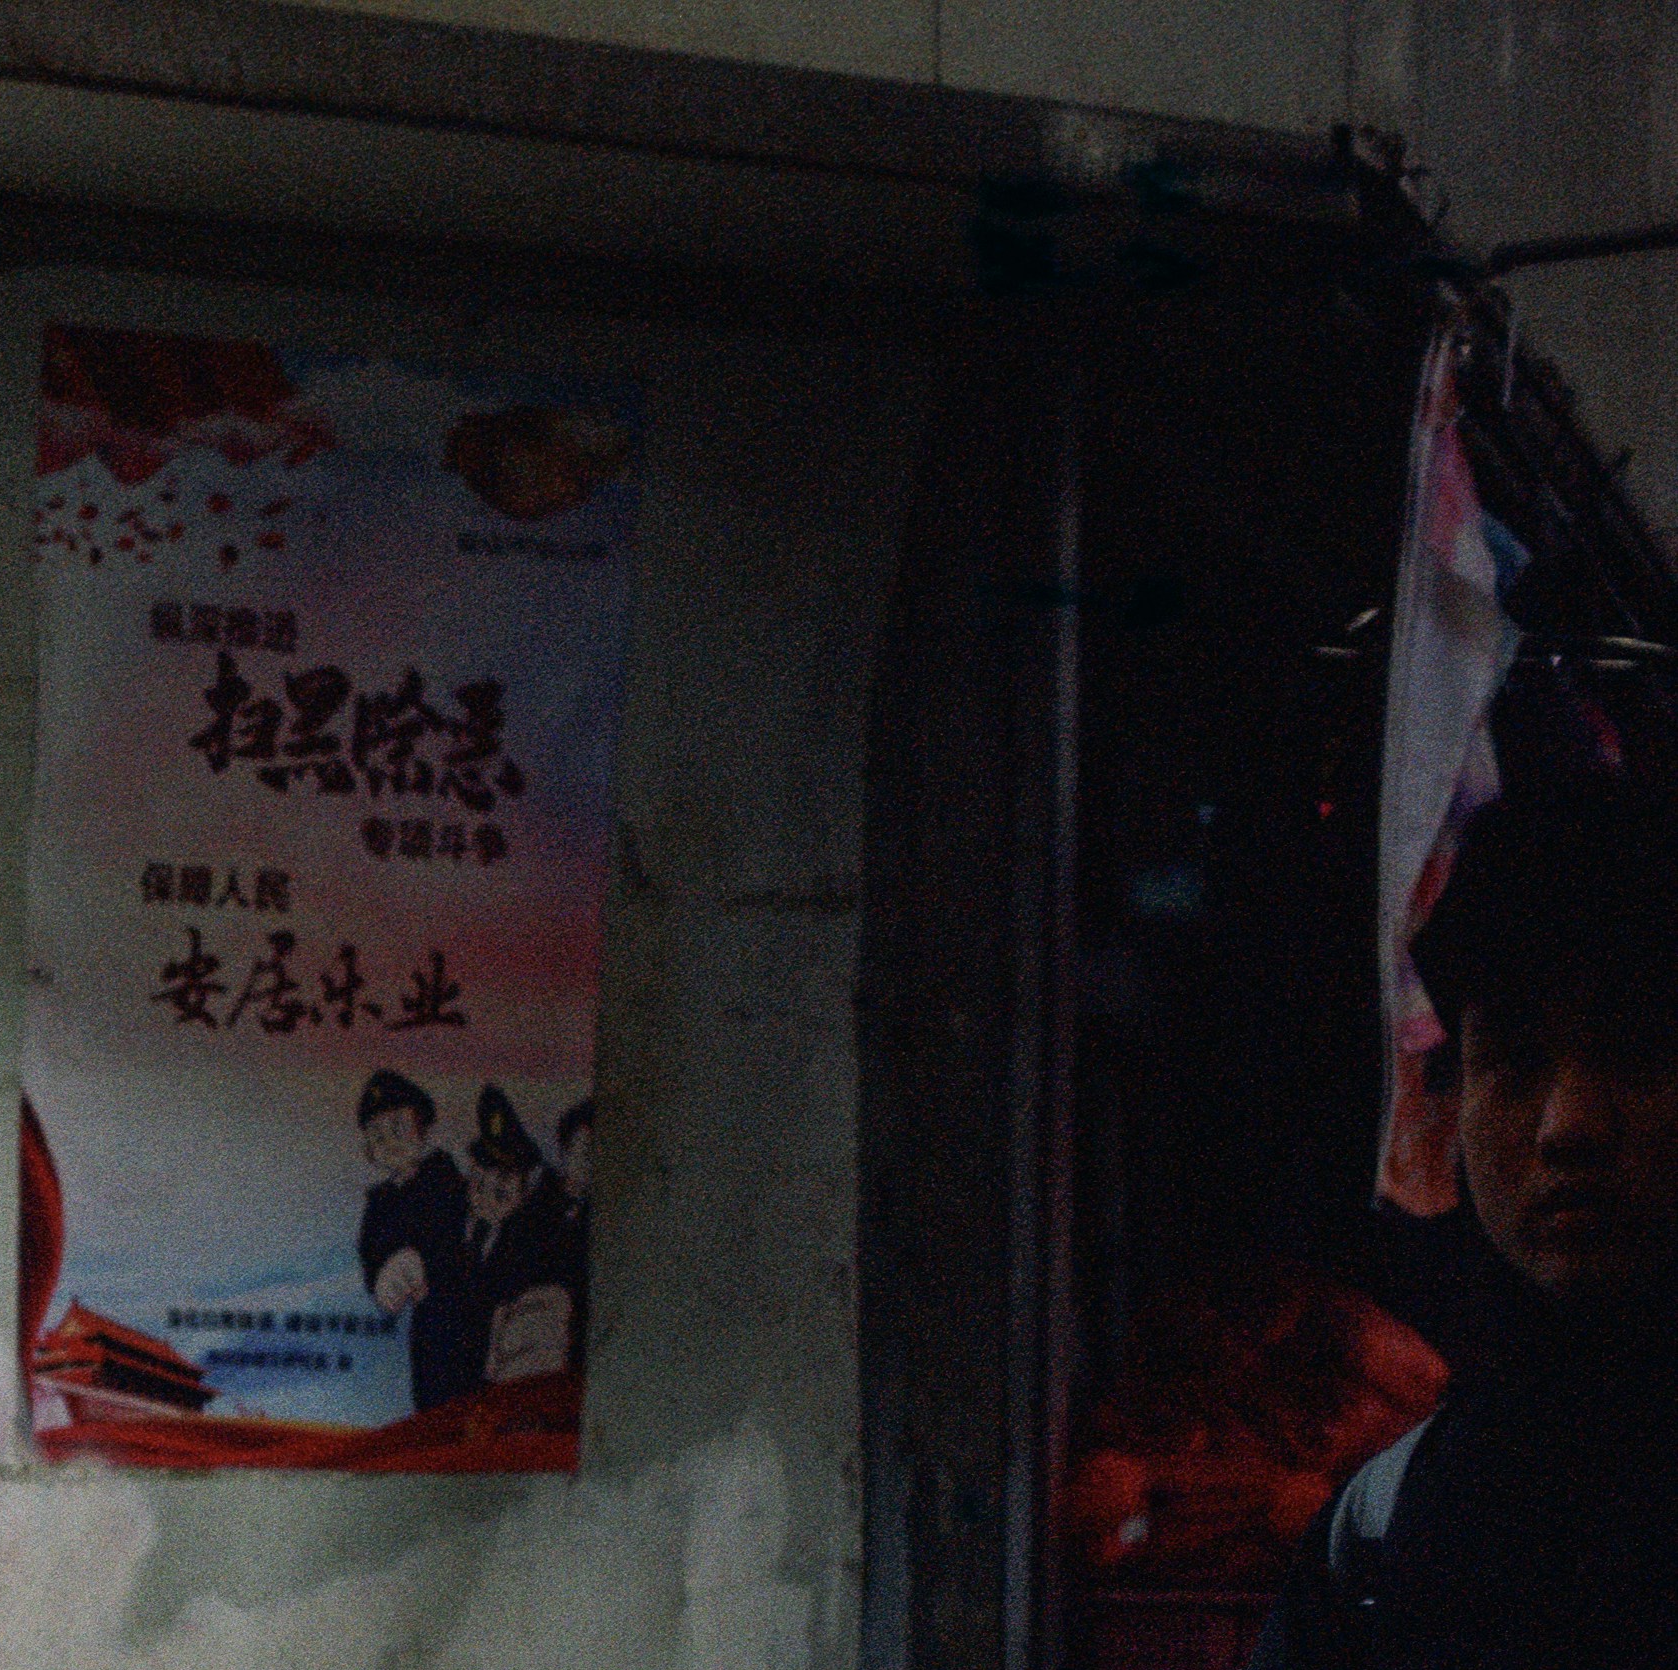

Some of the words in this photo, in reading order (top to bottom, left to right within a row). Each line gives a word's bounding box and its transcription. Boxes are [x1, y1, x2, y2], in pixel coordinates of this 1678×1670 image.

[190, 650, 525, 812] 扫黑除恶
[149, 926, 467, 1034] 安居乐业
